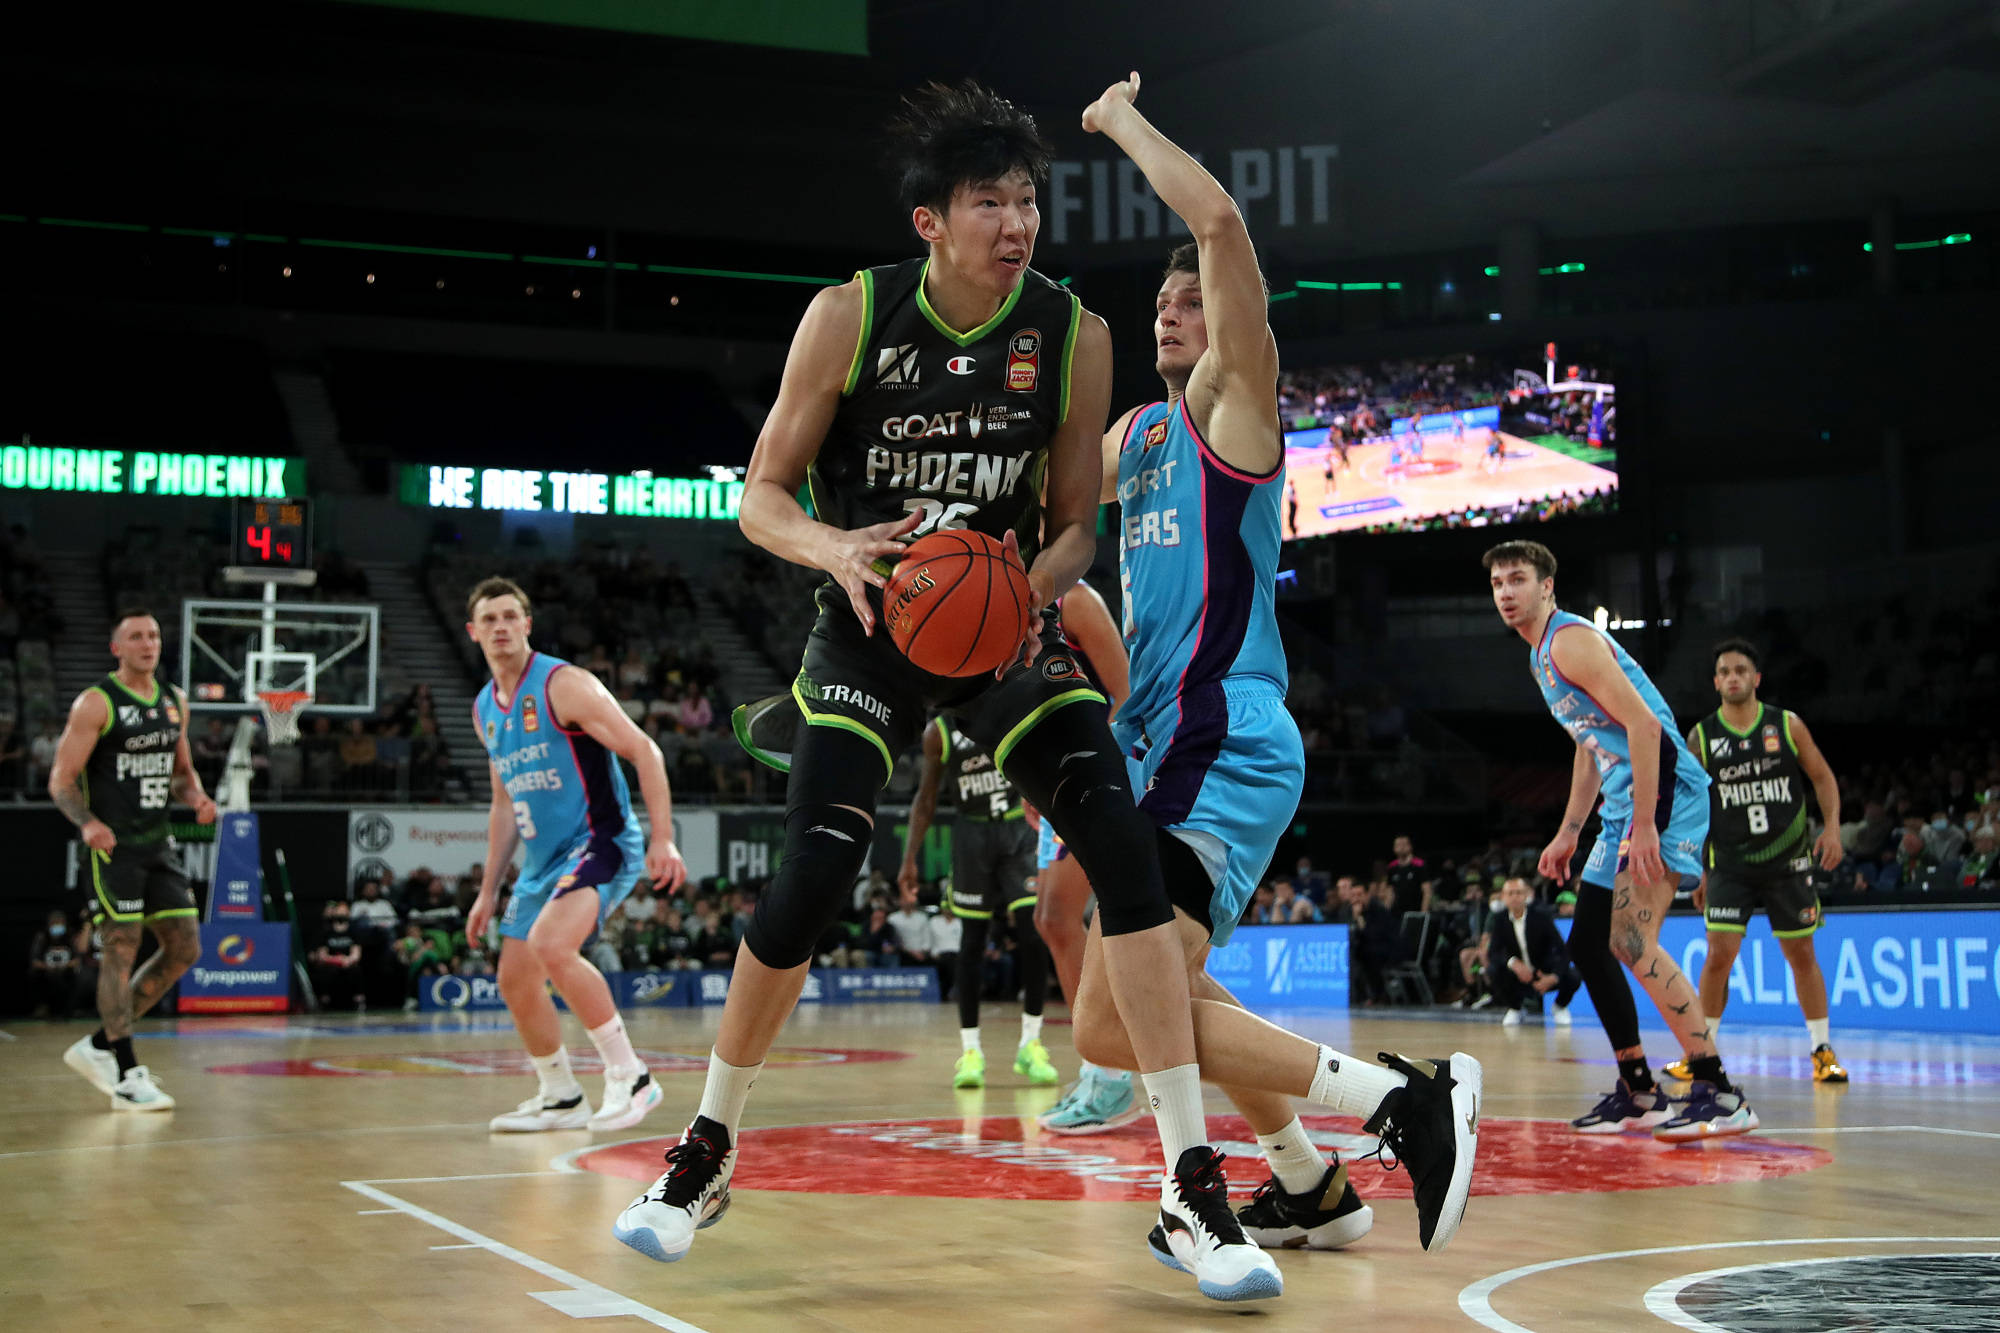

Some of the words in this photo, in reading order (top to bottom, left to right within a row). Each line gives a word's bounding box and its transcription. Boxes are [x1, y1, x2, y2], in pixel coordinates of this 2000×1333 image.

[1050, 155, 1201, 244] FIR
[1230, 145, 1339, 227] PIT
[882, 410, 964, 441] GOAT
[987, 410, 1031, 422] ENJOYABLE
[987, 421, 1007, 430] BEER
[989, 405, 1008, 414] VERY
[0, 446, 123, 493] OURNE
[133, 451, 287, 499] PHOENIX
[429, 465, 475, 508] WE
[481, 468, 543, 511] ARE
[549, 471, 609, 516] THE
[614, 475, 744, 520] HEARTLA
[247, 526, 271, 560] 4
[1122, 508, 1181, 554] ERS
[822, 684, 892, 726] TRADIE
[961, 752, 991, 773] GOA
[140, 777, 170, 809] 55
[957, 769, 1012, 802] PHOE
[1718, 776, 1793, 810] PHOENIX
[1747, 805, 1769, 834] 8
[1830, 936, 2000, 1009] ASHF
